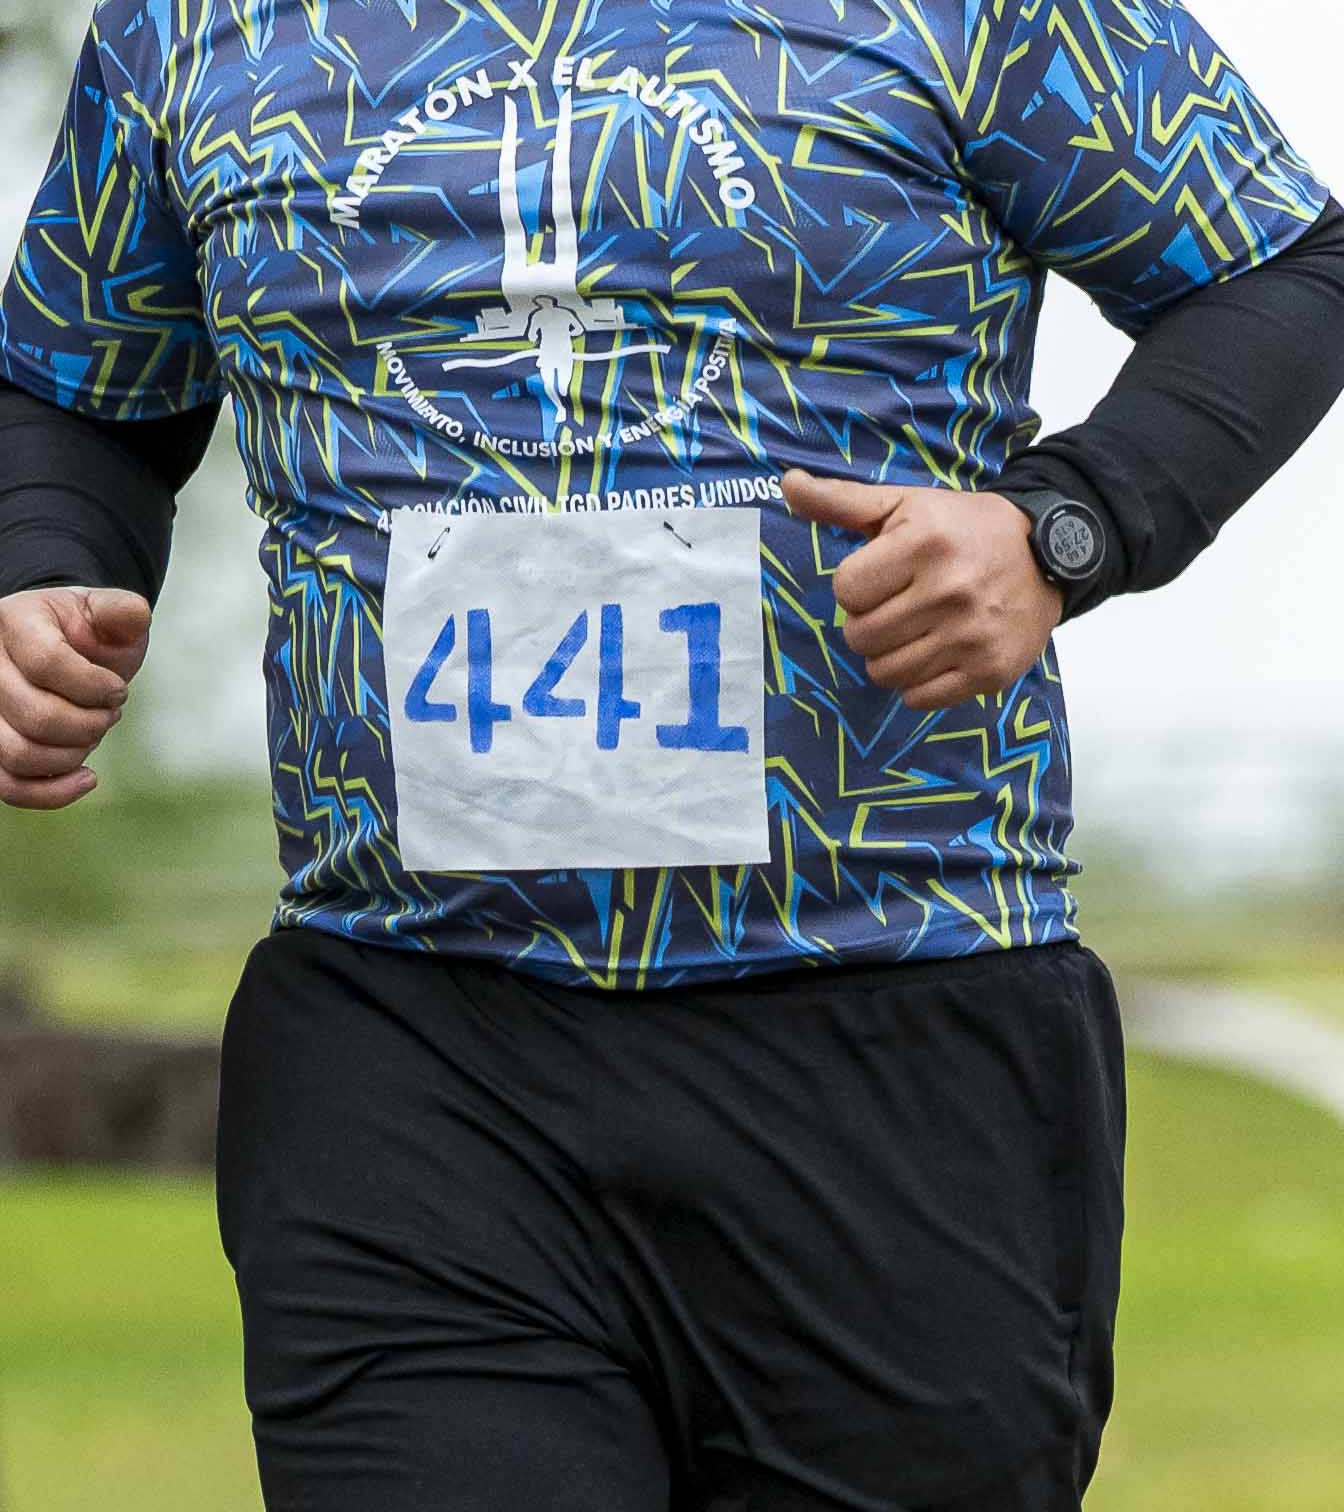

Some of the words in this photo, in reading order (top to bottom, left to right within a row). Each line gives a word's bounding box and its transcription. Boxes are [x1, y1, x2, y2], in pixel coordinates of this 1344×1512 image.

[329, 68, 494, 229] MARATÓN
[506, 58, 538, 91] X
[557, 55, 597, 90] EL
[607, 65, 756, 210] AUTISMO
[606, 483, 696, 512] PADRES
[699, 474, 785, 508] UNIDOS
[404, 601, 750, 754] 441
